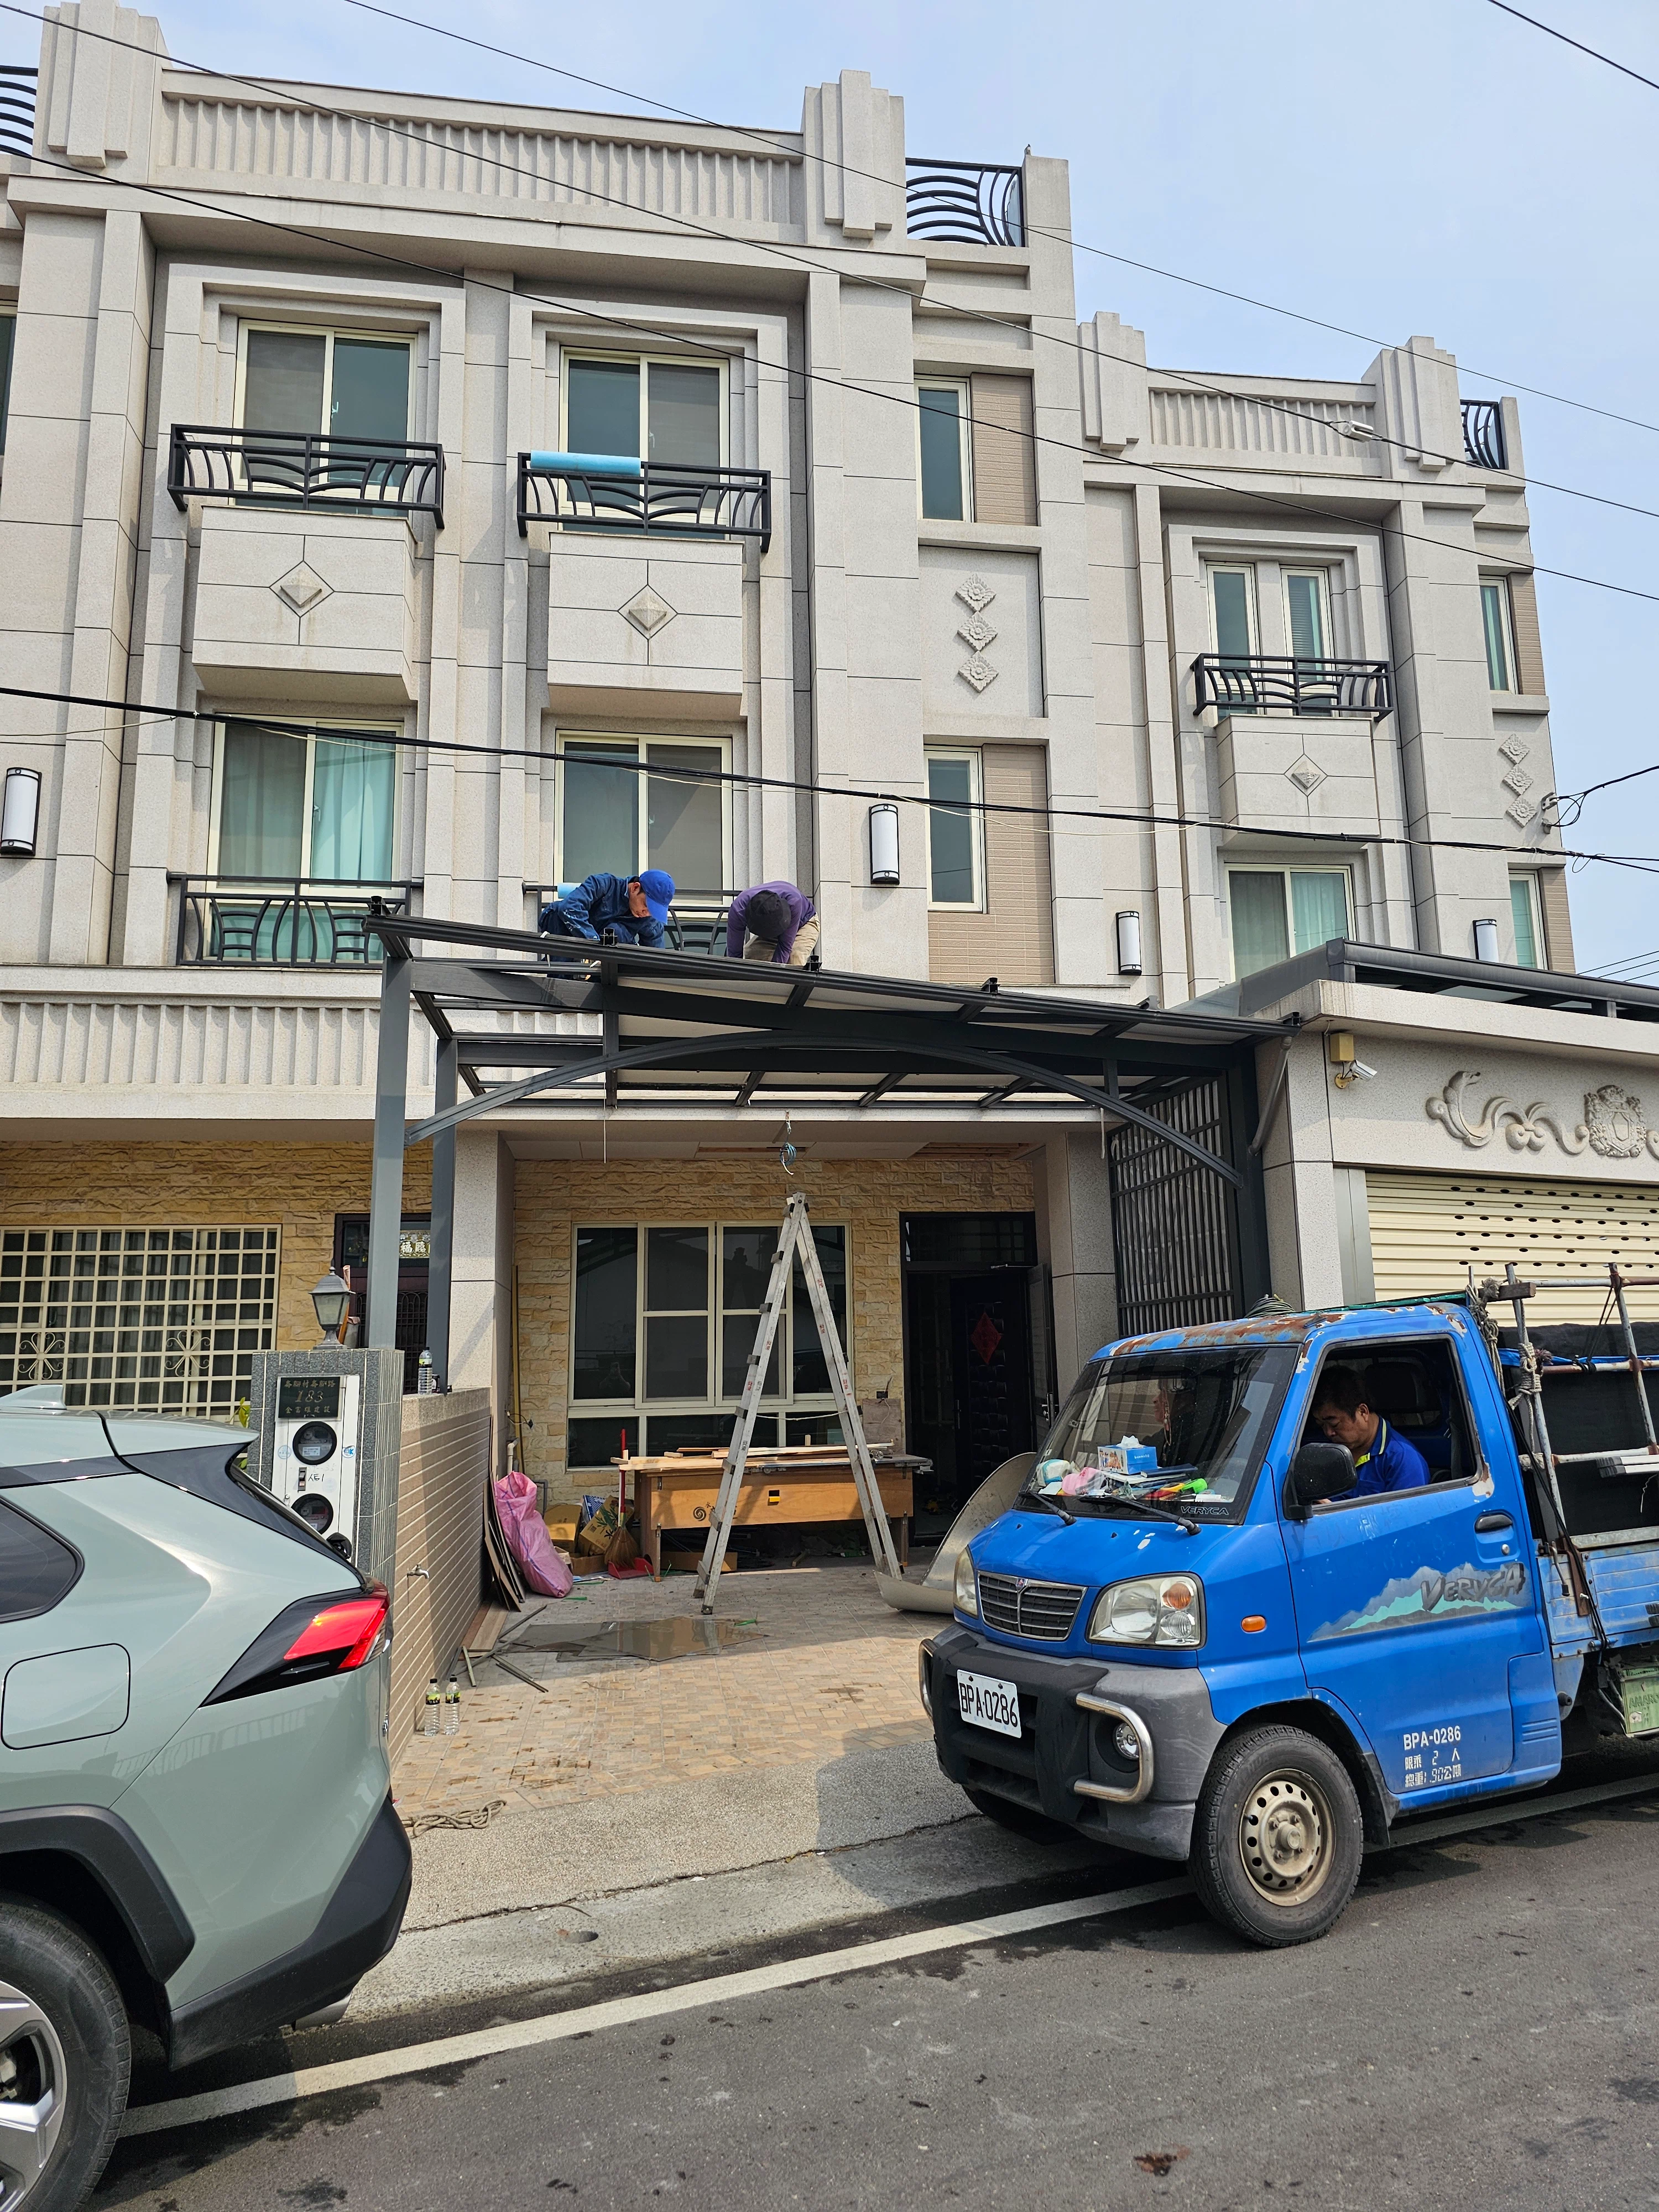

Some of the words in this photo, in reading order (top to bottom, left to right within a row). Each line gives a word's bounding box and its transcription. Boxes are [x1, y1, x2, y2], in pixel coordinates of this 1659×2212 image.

[295, 1390, 324, 1403] 183
[1180, 1506, 1229, 1515] VERYCA
[1403, 1725, 1461, 1751] BPA-0286
[1405, 1754, 1422, 1770] 限乘
[1432, 1750, 1438, 1766] 2
[1452, 1747, 1460, 1762] 人
